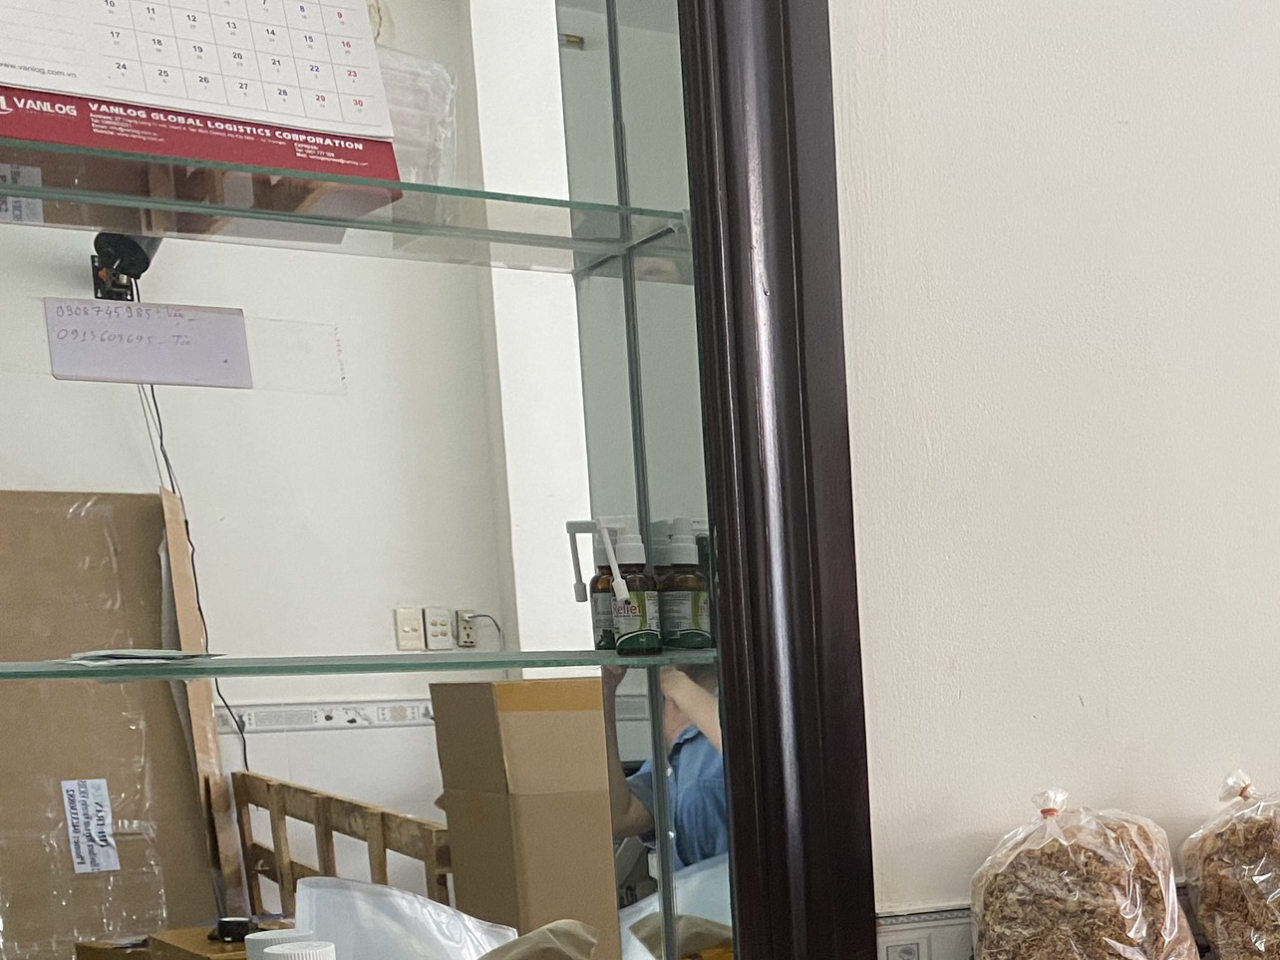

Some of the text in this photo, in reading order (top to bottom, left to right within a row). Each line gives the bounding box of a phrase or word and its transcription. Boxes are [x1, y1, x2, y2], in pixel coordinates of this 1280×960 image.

[226, 22, 237, 30] 13
[266, 28, 276, 36] 14
[342, 40, 352, 48] 16
[158, 70, 168, 78] 25
[199, 76, 210, 84] 26
[353, 99, 364, 107] 30
[14, 97, 78, 116] VANLOG
[88, 102, 147, 118] VANLOG
[150, 112, 204, 127] GLOBAL
[207, 120, 271, 136] LOGISTICS
[275, 131, 364, 150] CORPORATION
